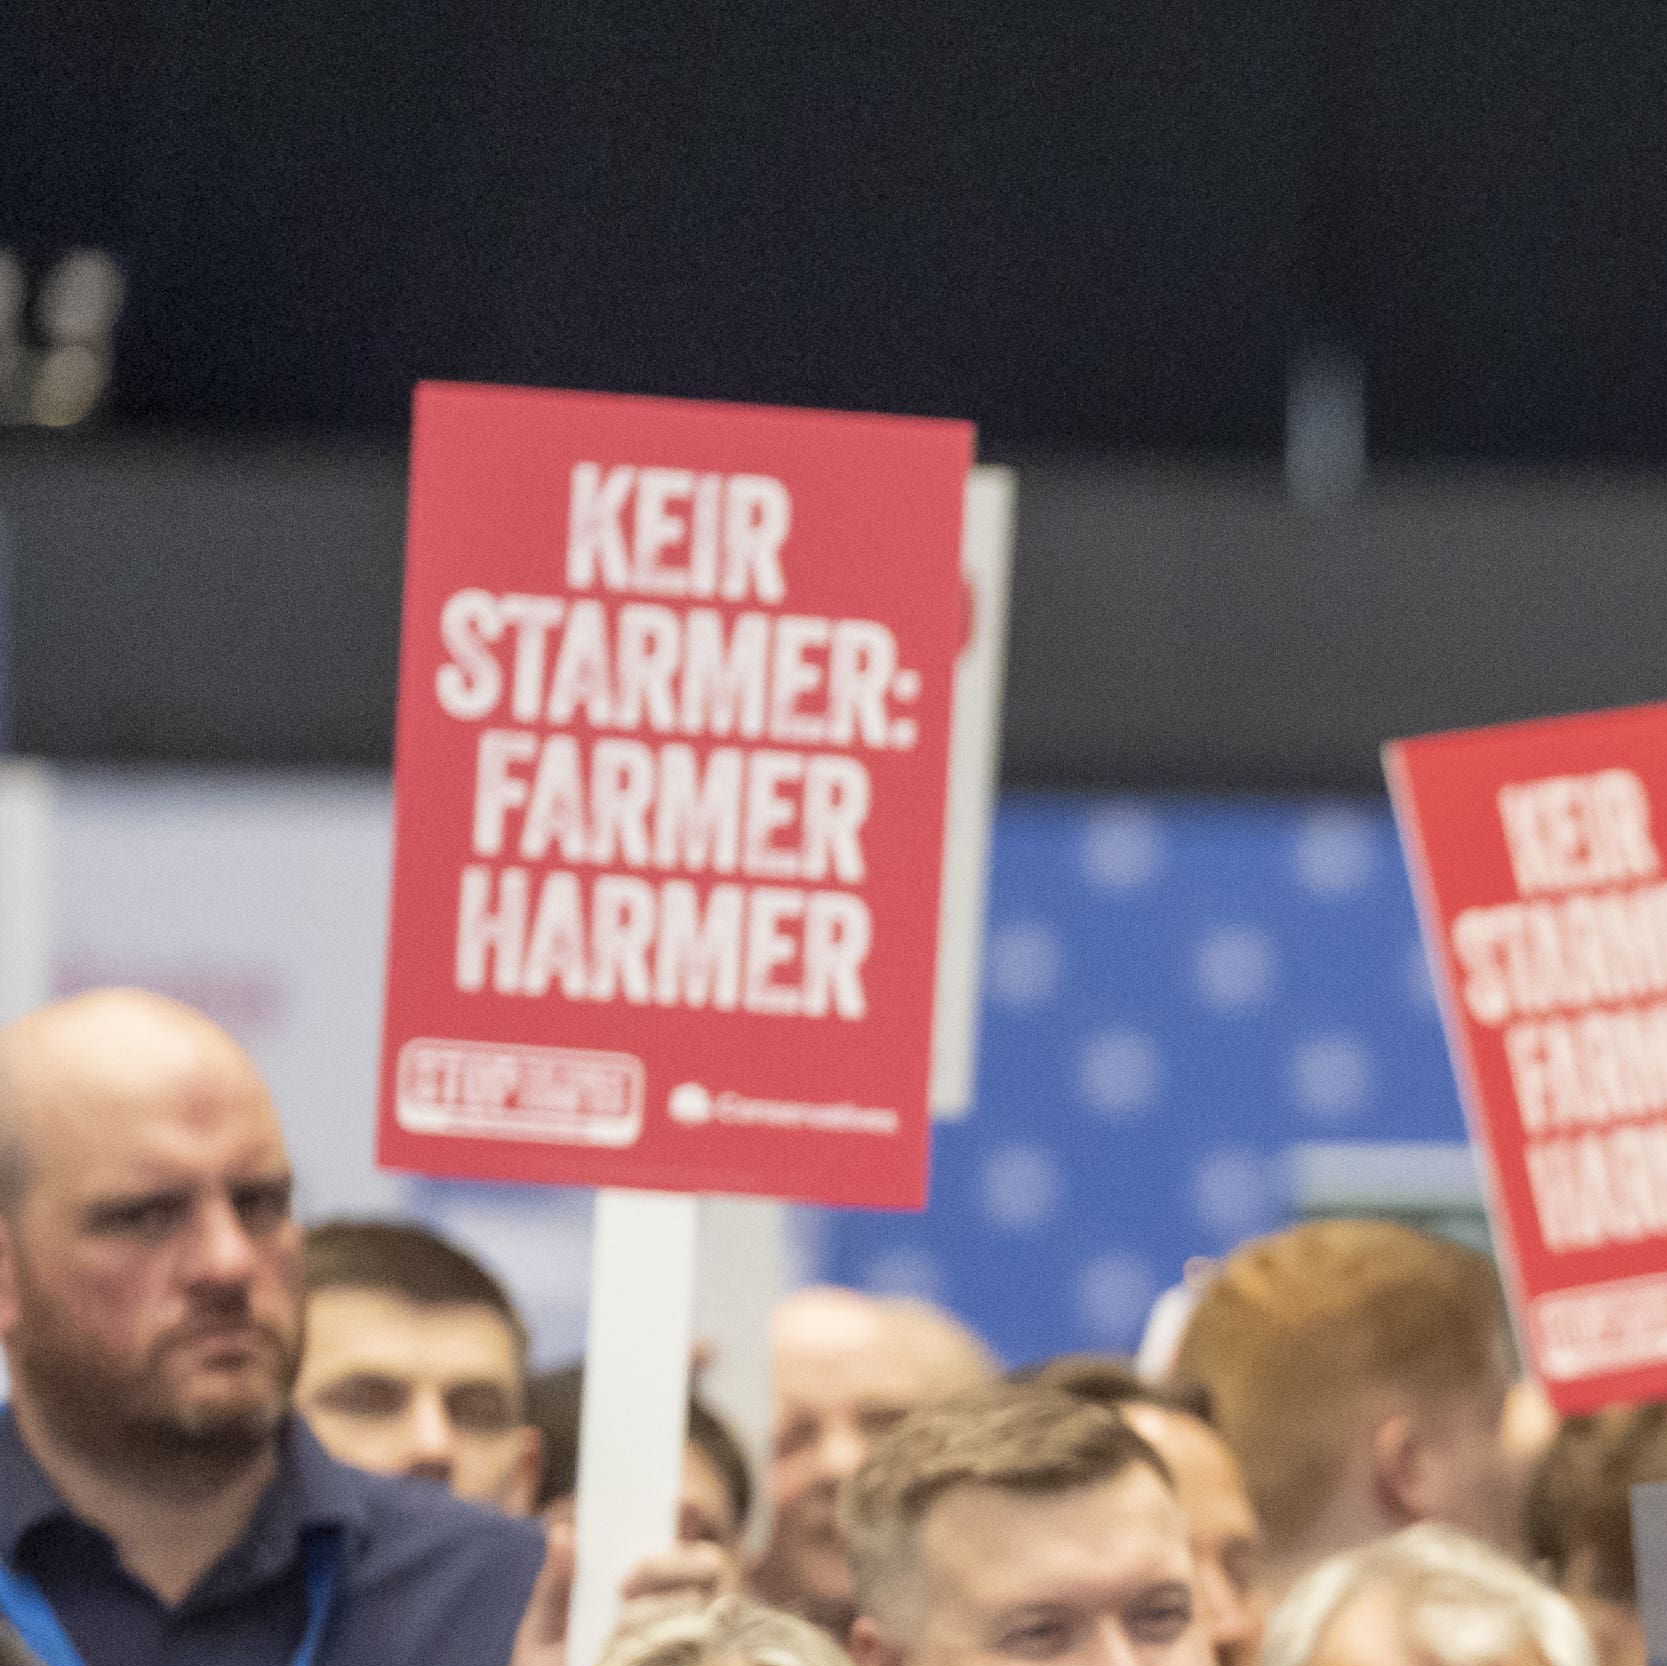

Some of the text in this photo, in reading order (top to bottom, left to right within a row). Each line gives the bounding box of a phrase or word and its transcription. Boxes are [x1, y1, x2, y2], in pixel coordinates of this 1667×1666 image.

[567, 460, 792, 602] KEIR
[435, 588, 921, 750] STARMER:
[473, 728, 871, 884] FARMER
[455, 866, 873, 1020] HARMER
